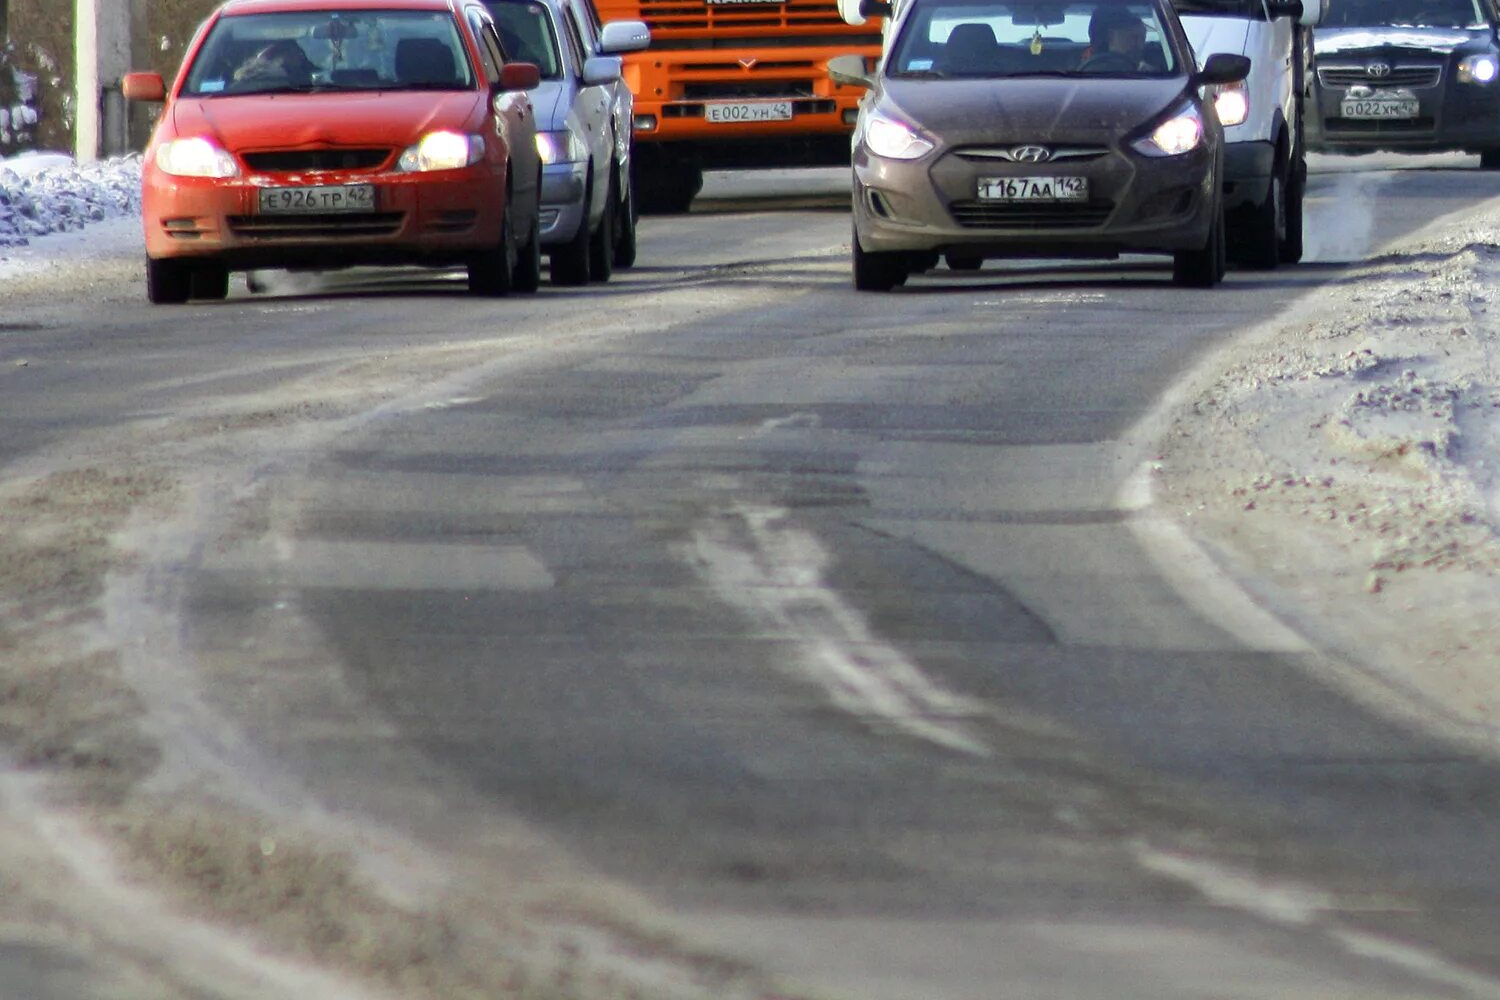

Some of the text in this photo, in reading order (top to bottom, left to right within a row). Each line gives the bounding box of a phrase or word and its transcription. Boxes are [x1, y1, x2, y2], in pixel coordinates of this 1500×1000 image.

[348, 187, 366, 201] 42
[984, 178, 1082, 197] Т167АА 142
